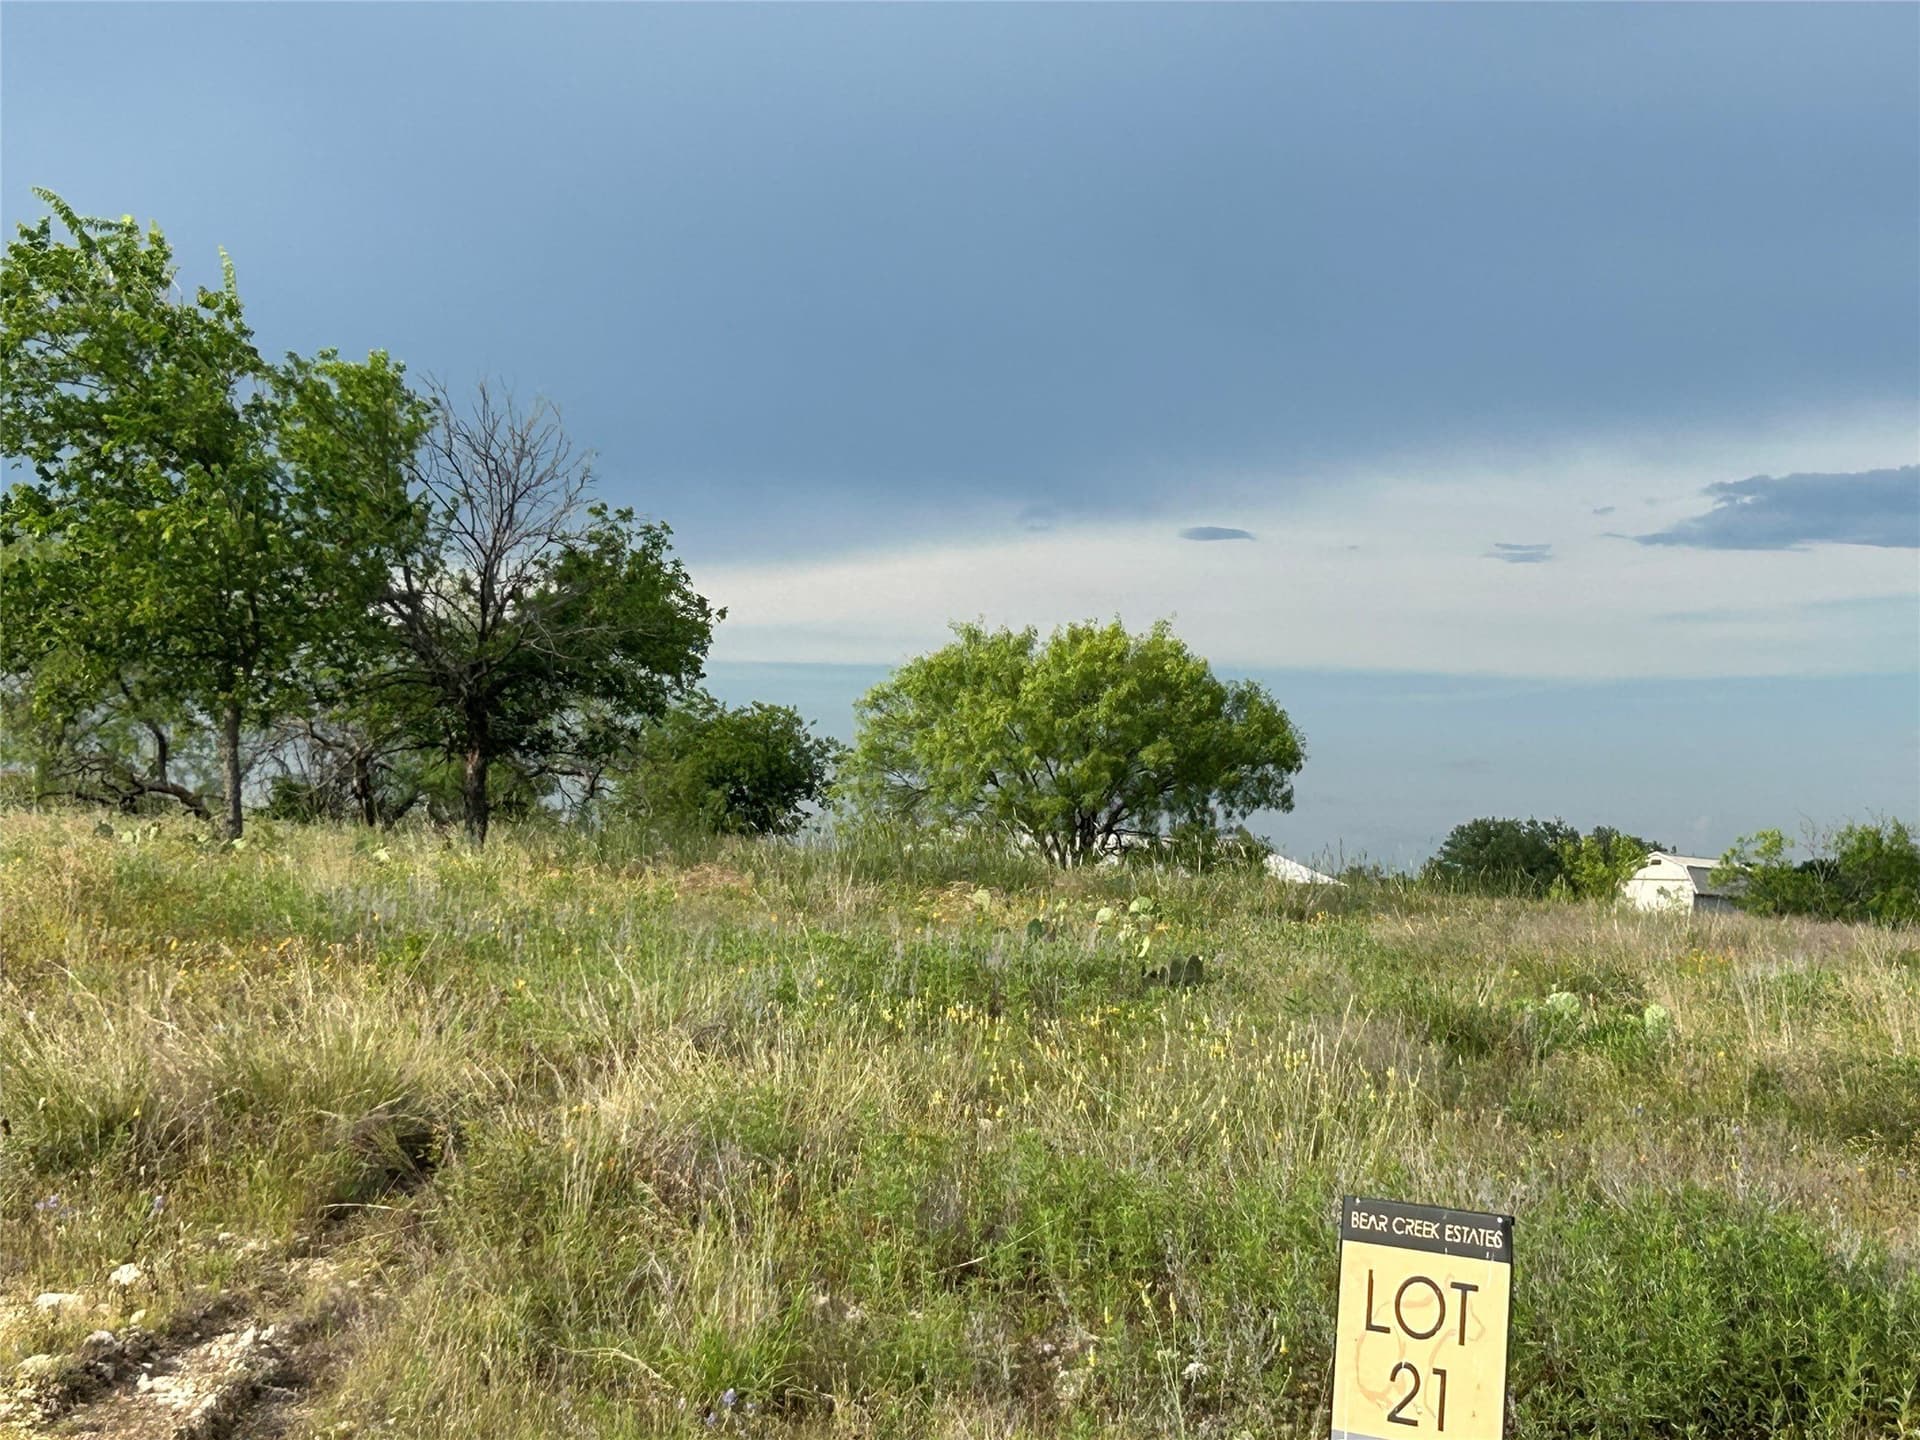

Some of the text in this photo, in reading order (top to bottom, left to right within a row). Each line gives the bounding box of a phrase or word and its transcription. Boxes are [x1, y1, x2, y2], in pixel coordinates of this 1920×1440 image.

[1351, 1211, 1503, 1249] BEAR CREEK ESTATES
[1365, 1269, 1479, 1346] LOT
[1387, 1361, 1447, 1432] 21
